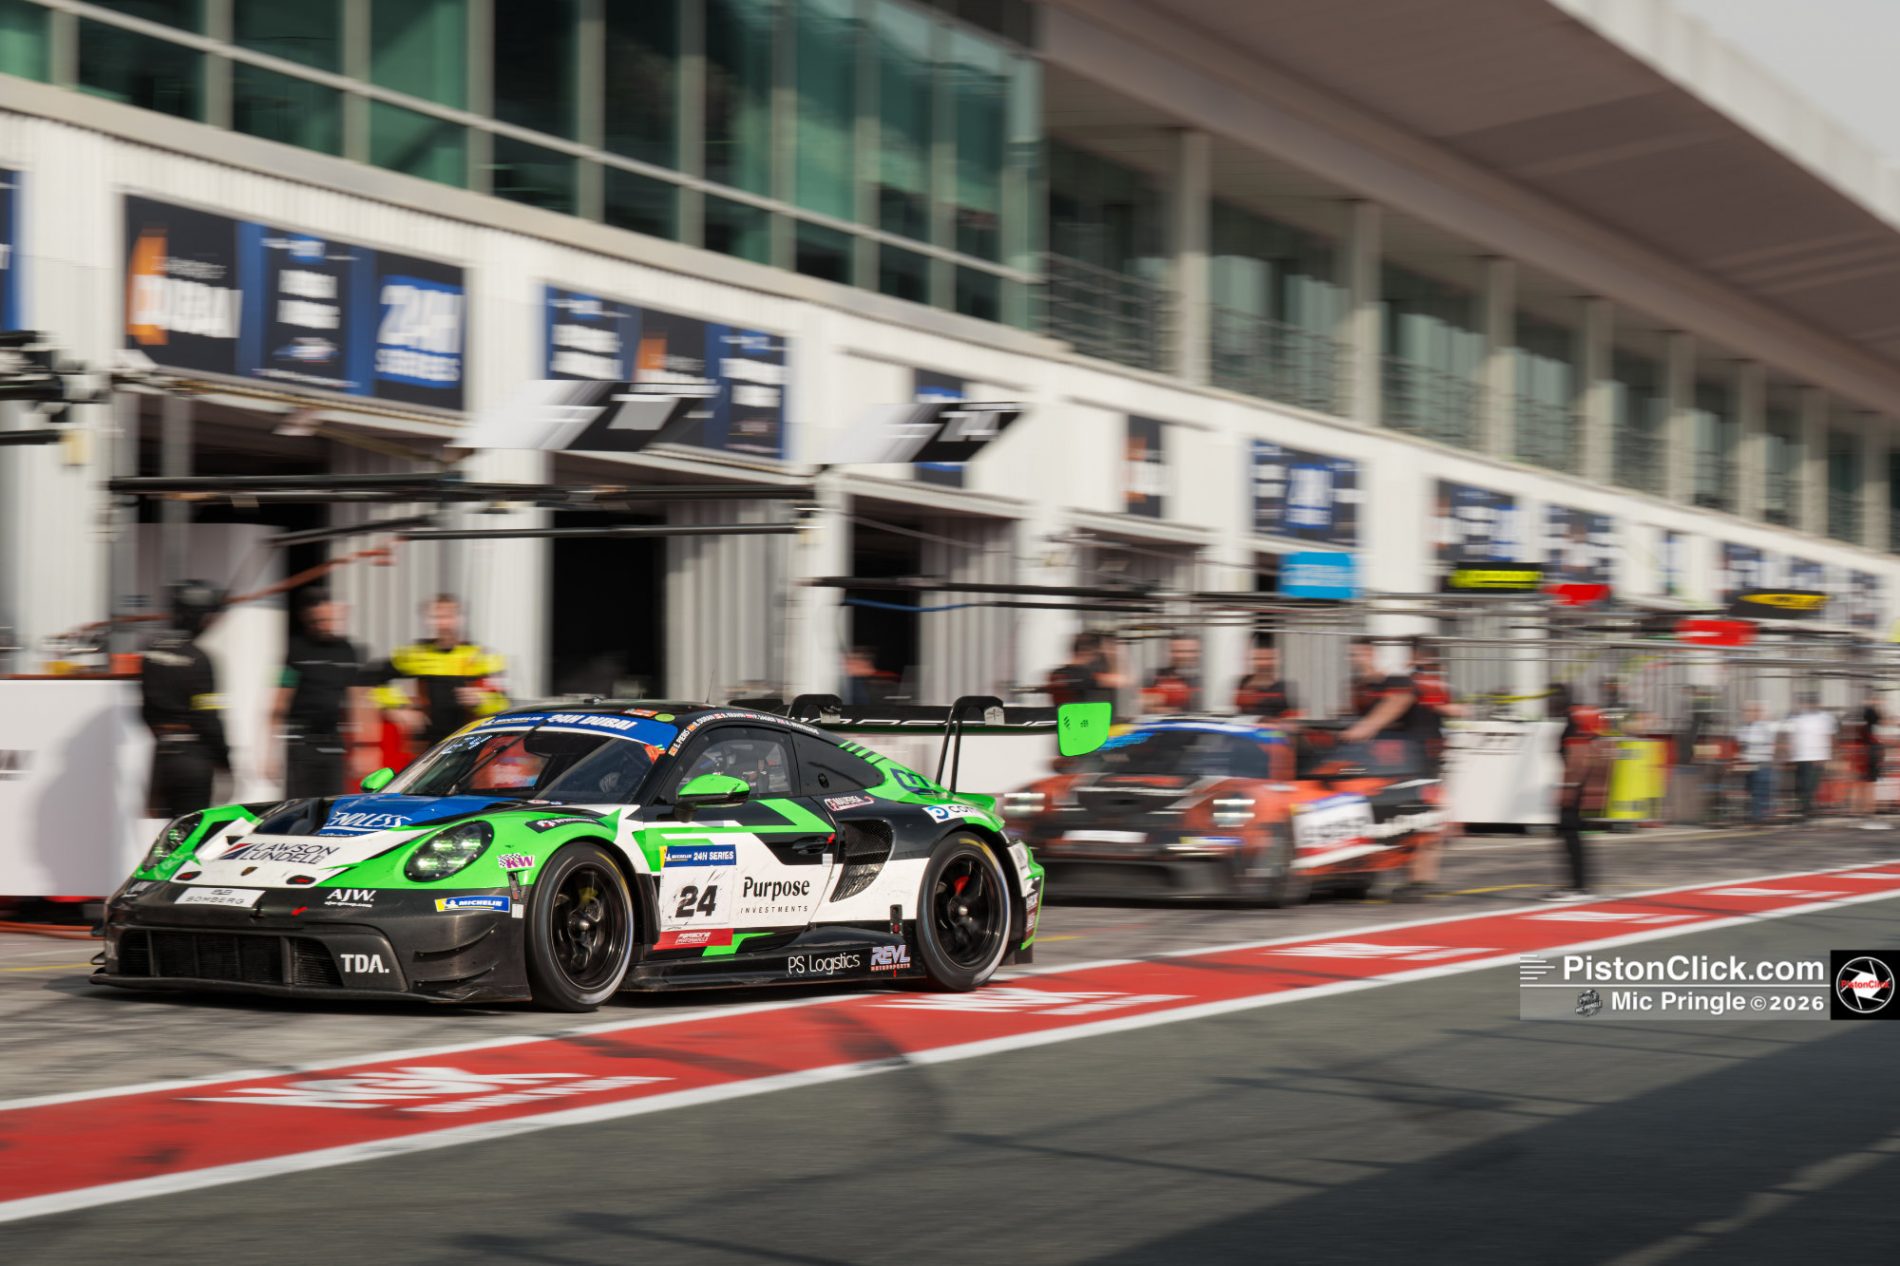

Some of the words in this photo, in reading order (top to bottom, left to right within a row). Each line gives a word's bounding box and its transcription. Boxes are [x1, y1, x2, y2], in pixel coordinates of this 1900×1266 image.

[546, 714, 581, 725] 24H
[579, 715, 638, 731] DUBAI
[239, 850, 321, 865] LUNDELL
[252, 843, 340, 856] LAWSON
[693, 852, 708, 861] 24H
[709, 851, 734, 860] SERIES
[505, 856, 534, 869] KW
[742, 876, 810, 902] Purpose
[459, 899, 504, 907] MICHELIN
[675, 884, 719, 918] 24
[740, 905, 809, 914] INVESTMENTS
[870, 944, 911, 966] REVL
[340, 953, 390, 974] TDA.
[787, 955, 805, 975] PS
[809, 952, 860, 975] Logistics
